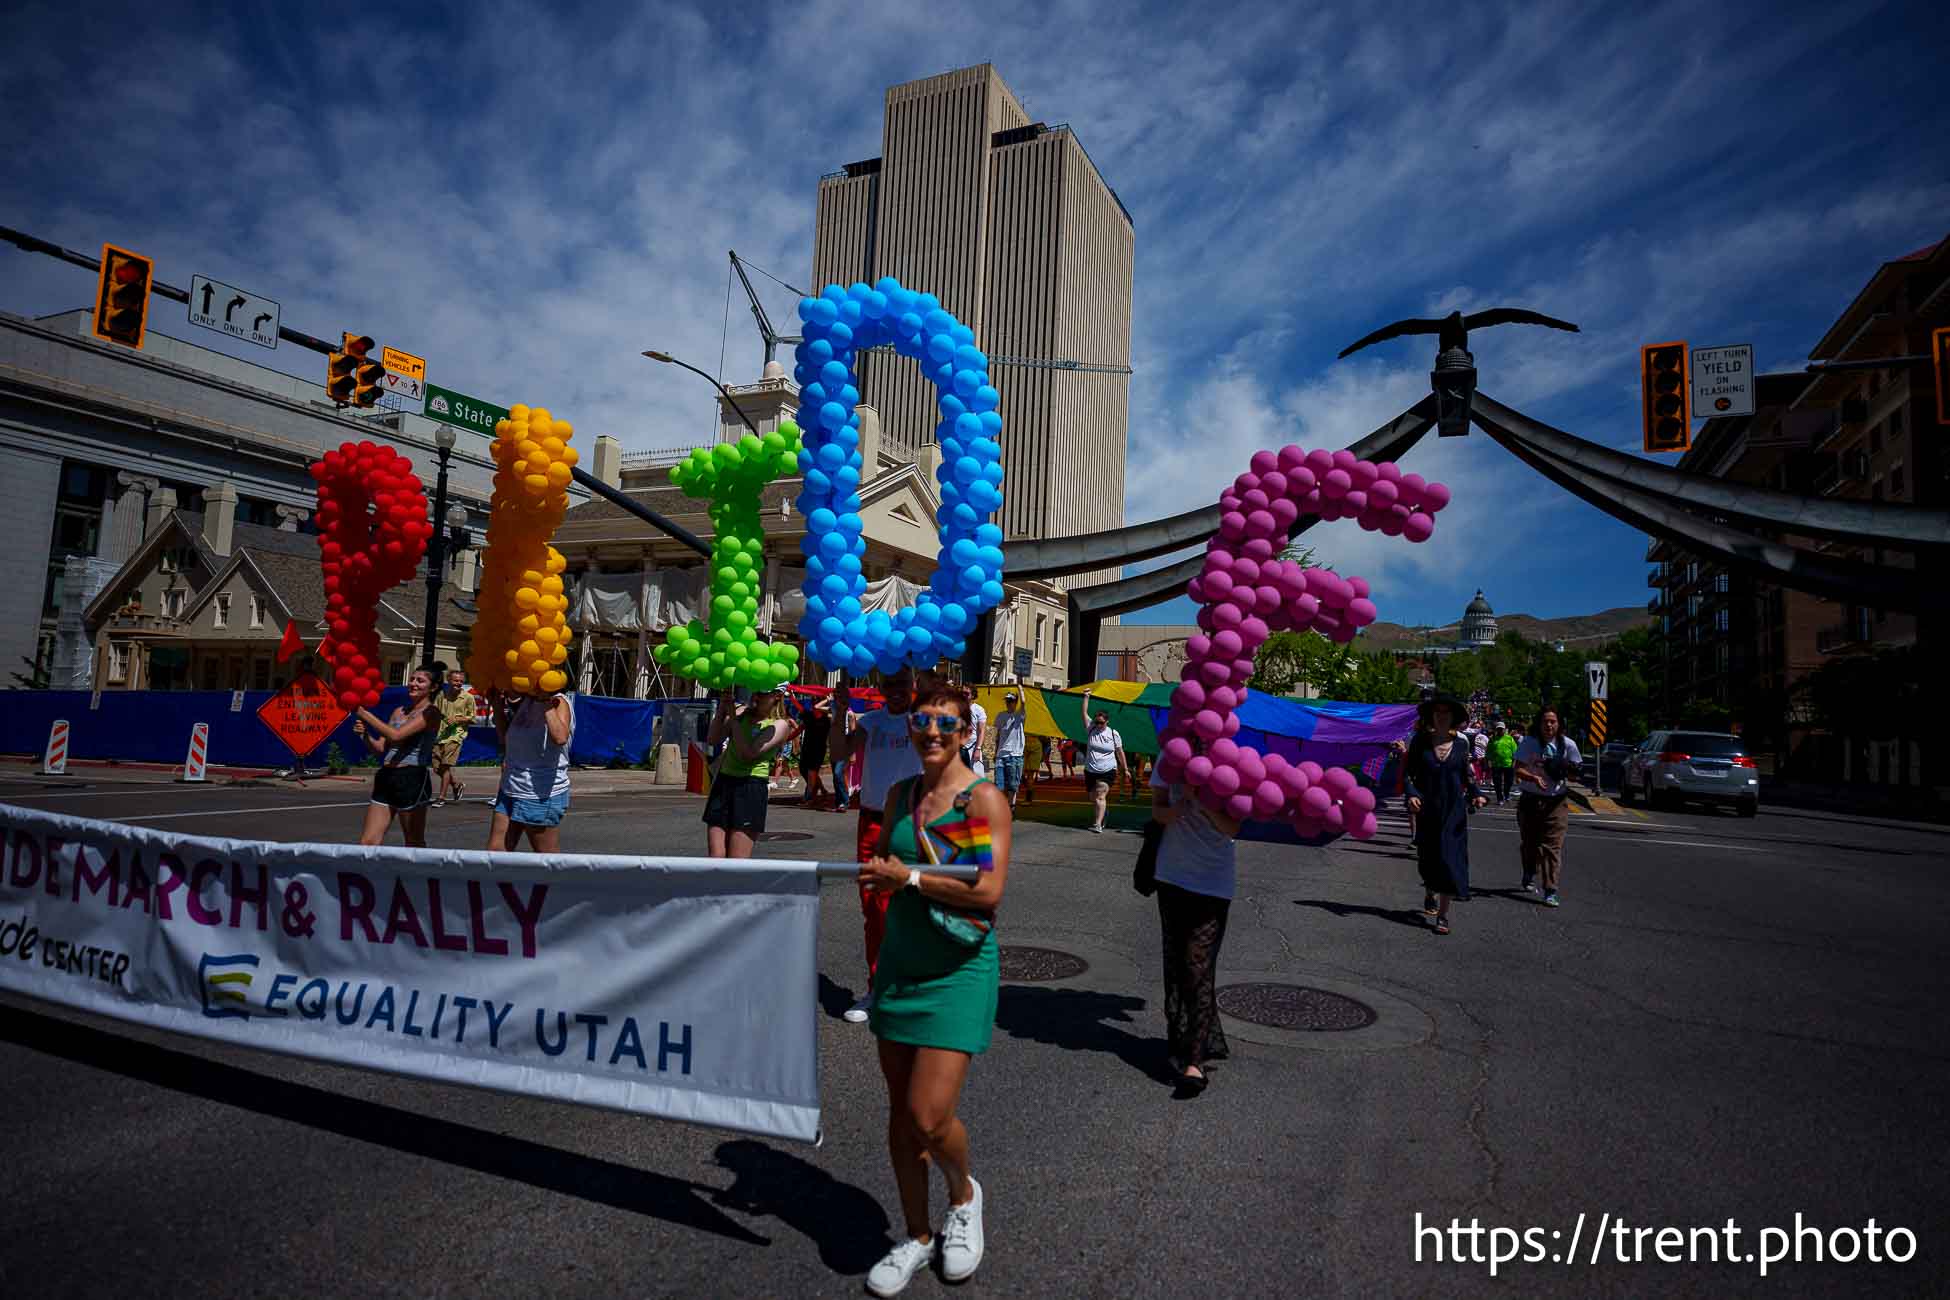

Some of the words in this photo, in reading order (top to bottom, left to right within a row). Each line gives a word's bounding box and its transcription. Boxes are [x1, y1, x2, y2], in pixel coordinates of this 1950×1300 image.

[193, 313, 216, 327] ONLY
[223, 322, 244, 336] ONLY
[252, 332, 272, 345] ONLY
[1696, 351, 1718, 361] LEFT
[1724, 348, 1747, 358] TURN
[1703, 361, 1741, 375] YIELD
[400, 381, 408, 389] TO
[1716, 376, 1728, 384] ON
[1699, 384, 1745, 396] FLASHING
[433, 399, 446, 410] 186
[454, 402, 493, 427] State
[72, 841, 269, 931] MARCH
[281, 881, 316, 939] &
[337, 871, 549, 960] RALLY
[42, 938, 130, 986] CENTER
[265, 974, 514, 1048] EQUALITY
[535, 1008, 692, 1075] UTAH
